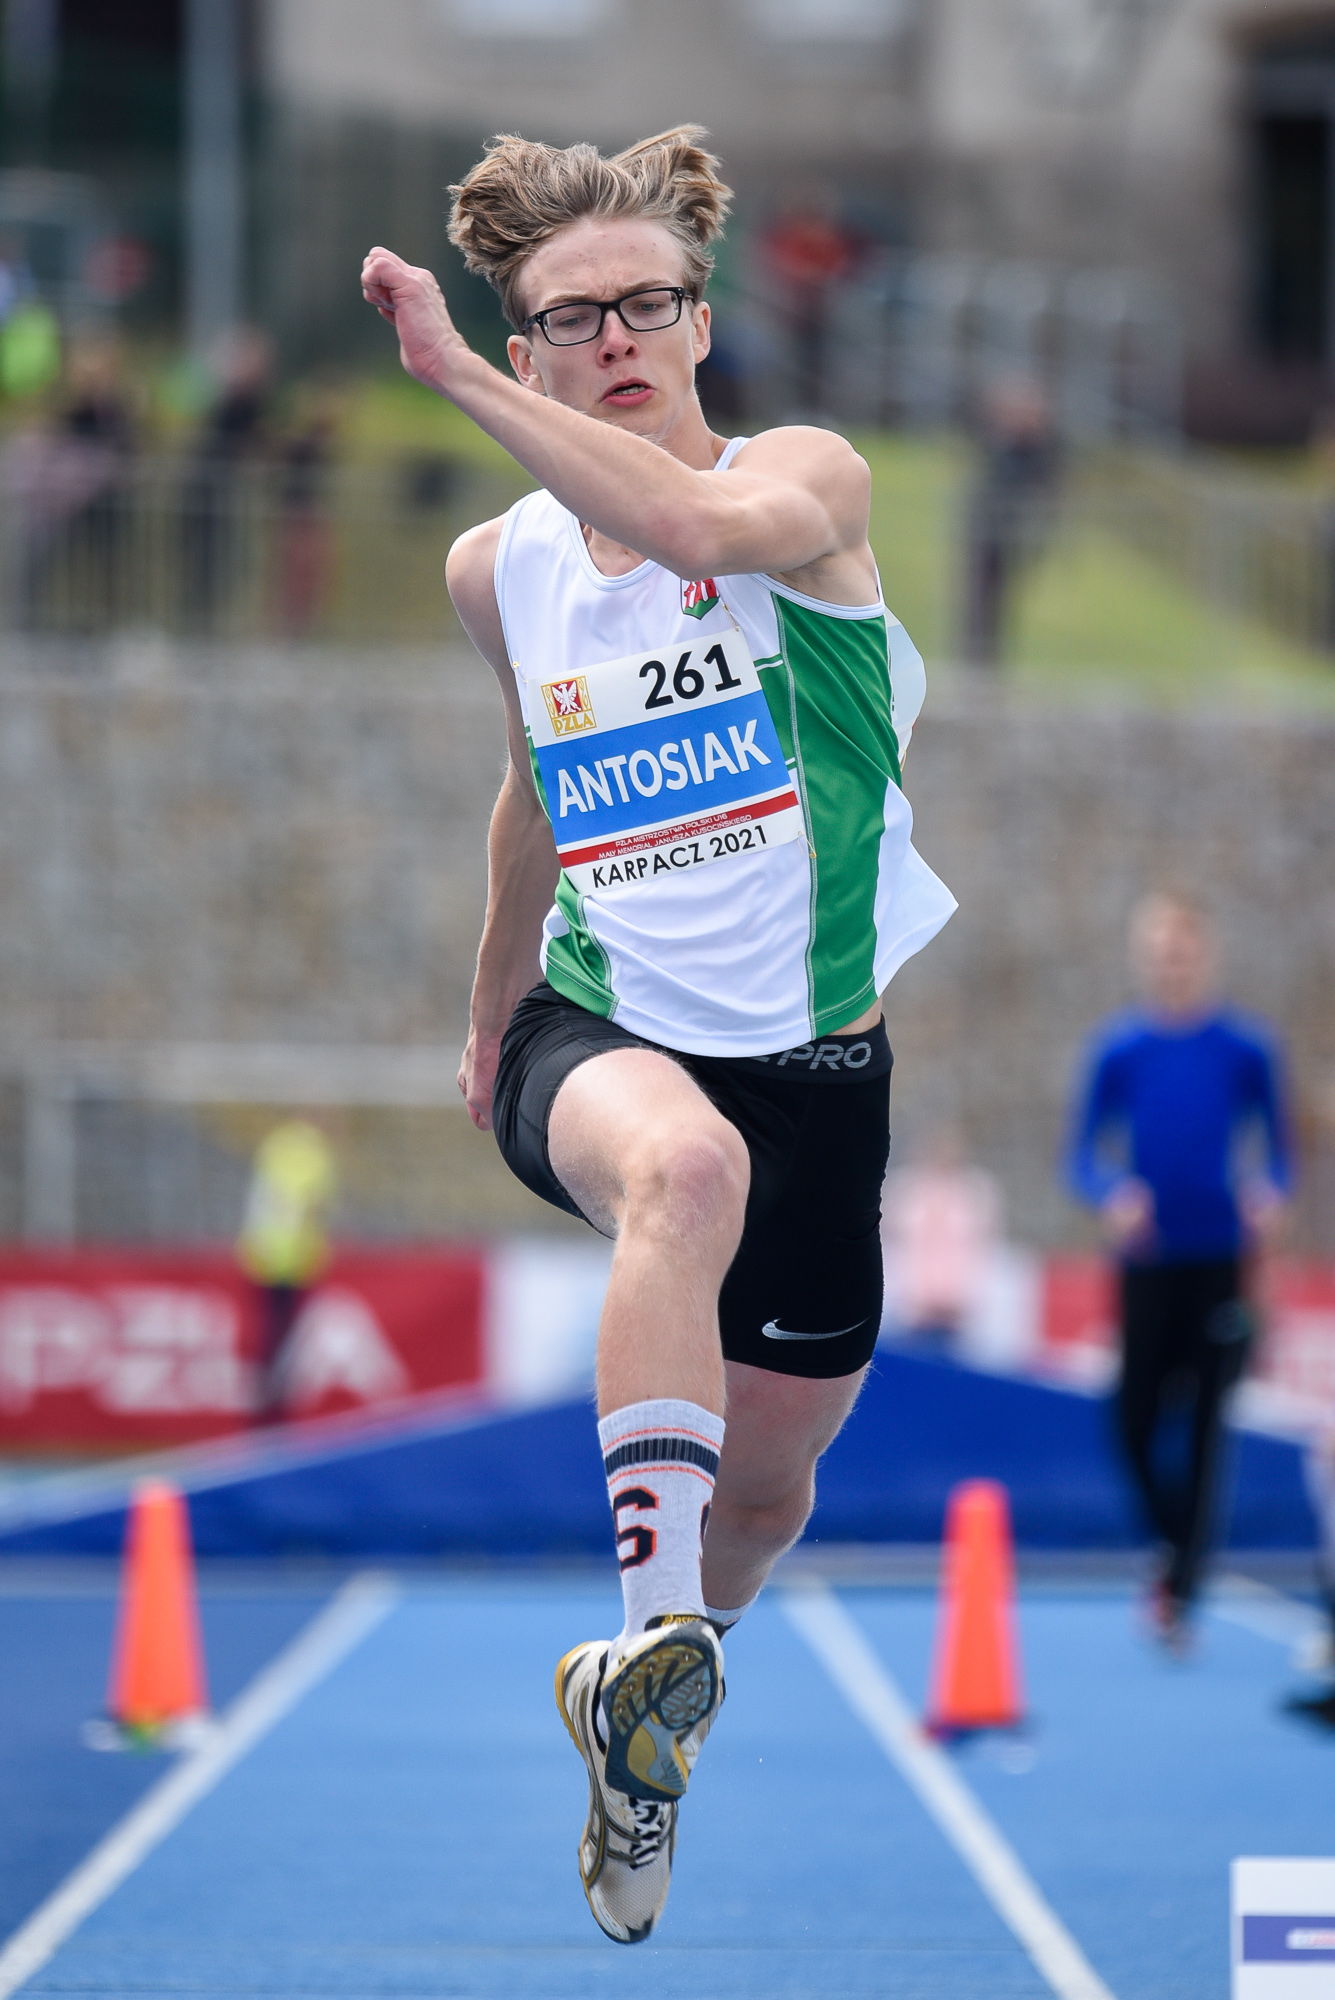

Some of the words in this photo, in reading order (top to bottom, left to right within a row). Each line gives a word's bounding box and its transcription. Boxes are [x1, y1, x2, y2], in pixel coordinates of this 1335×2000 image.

[639, 643, 742, 710] 261
[553, 712, 594, 734] PZLA
[558, 718, 772, 819] ANTOSIAK
[615, 837, 633, 848] PZLA
[633, 825, 686, 844] MISTRZOSTWA
[685, 817, 713, 830] POLSKI
[713, 812, 729, 823] U16
[654, 831, 691, 847] JANUSZA
[592, 842, 705, 889] KARPACZ
[709, 825, 768, 859] 2021
[776, 1041, 872, 1071] PRO
